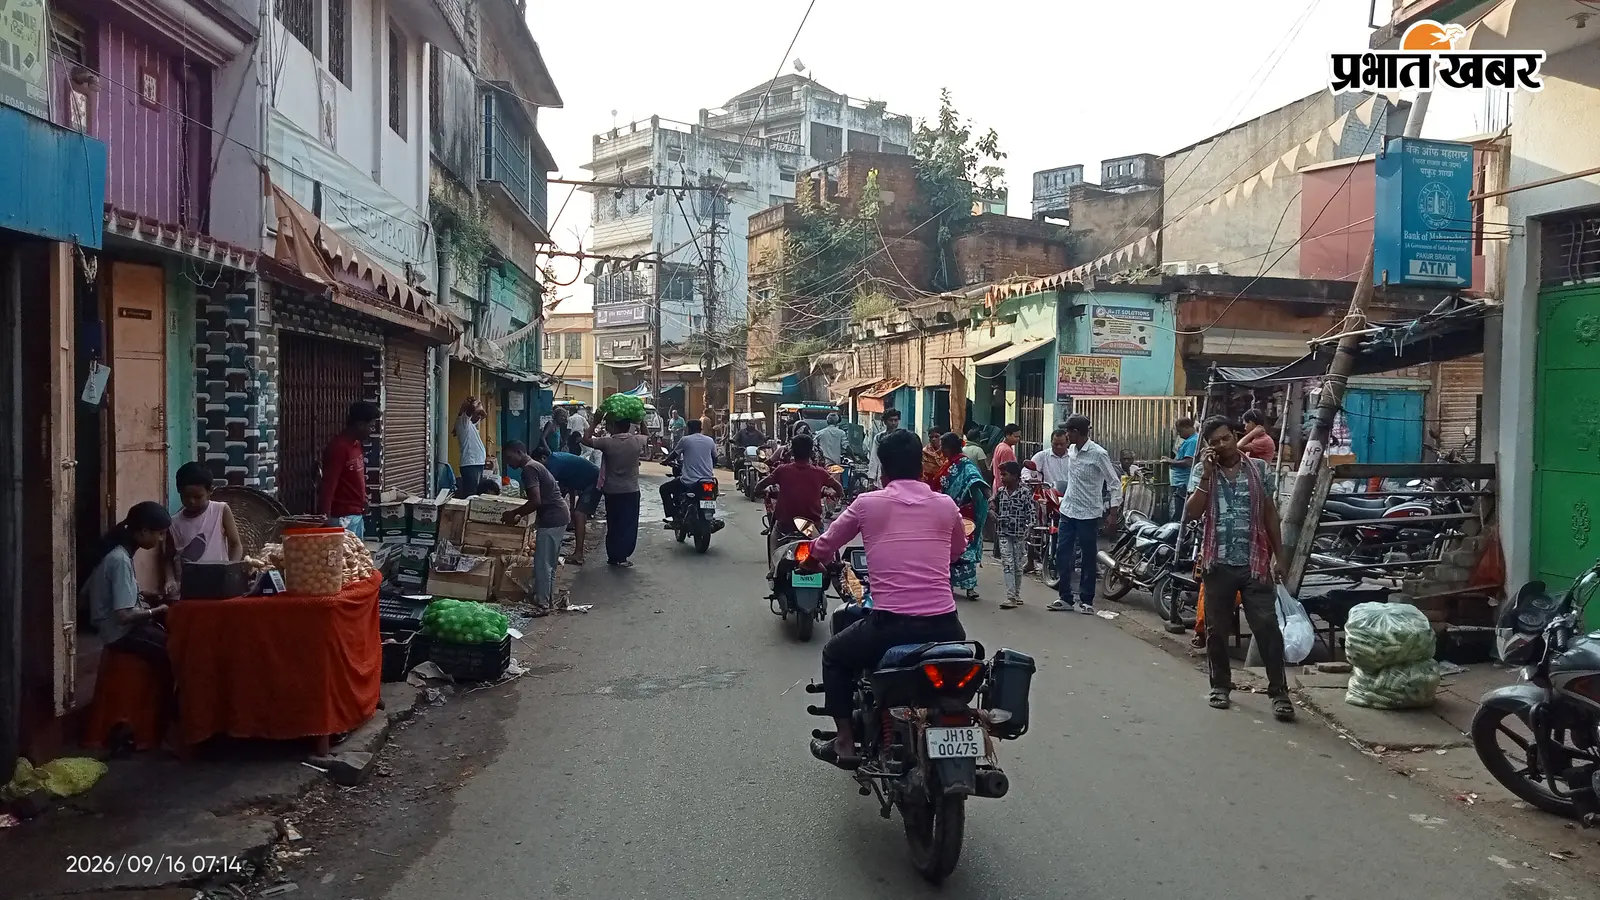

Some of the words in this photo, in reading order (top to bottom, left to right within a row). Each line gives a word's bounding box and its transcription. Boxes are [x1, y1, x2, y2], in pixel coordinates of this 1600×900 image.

[1422, 145, 1439, 157] ऑफ
[1441, 149, 1468, 162] महाराष्ट्र
[1404, 230, 1420, 240] Bank
[1421, 231, 1429, 241] of
[1416, 252, 1434, 260] PAKUR
[1434, 253, 1456, 261] BRANCH
[1419, 261, 1449, 275] ATM
[1060, 356, 1086, 366] NUZHAT
[1088, 358, 1119, 368] FASHIONS
[943, 729, 974, 742] JH18
